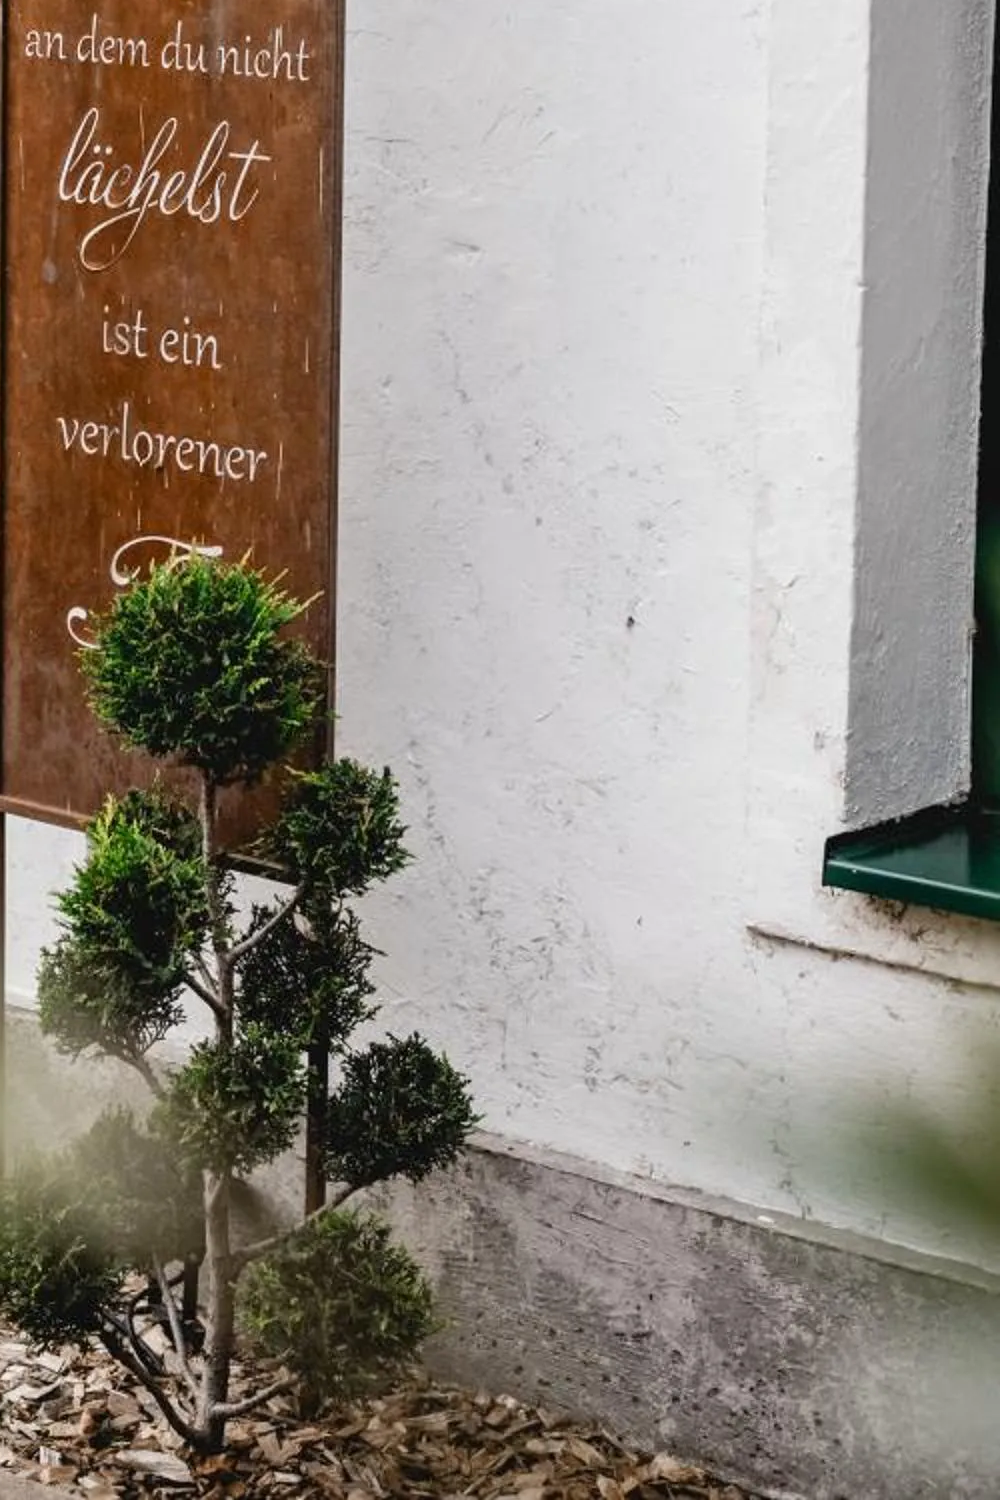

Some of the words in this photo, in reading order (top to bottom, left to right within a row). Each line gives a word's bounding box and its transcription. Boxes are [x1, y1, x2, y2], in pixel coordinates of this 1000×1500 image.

[24, 27, 65, 60] an
[76, 13, 149, 68] dem
[160, 20, 206, 74] du
[217, 26, 311, 81] nicht
[58, 107, 272, 272] lächelst
[102, 304, 147, 358] ist
[159, 316, 222, 370] ein
[56, 401, 267, 482] verlorener
